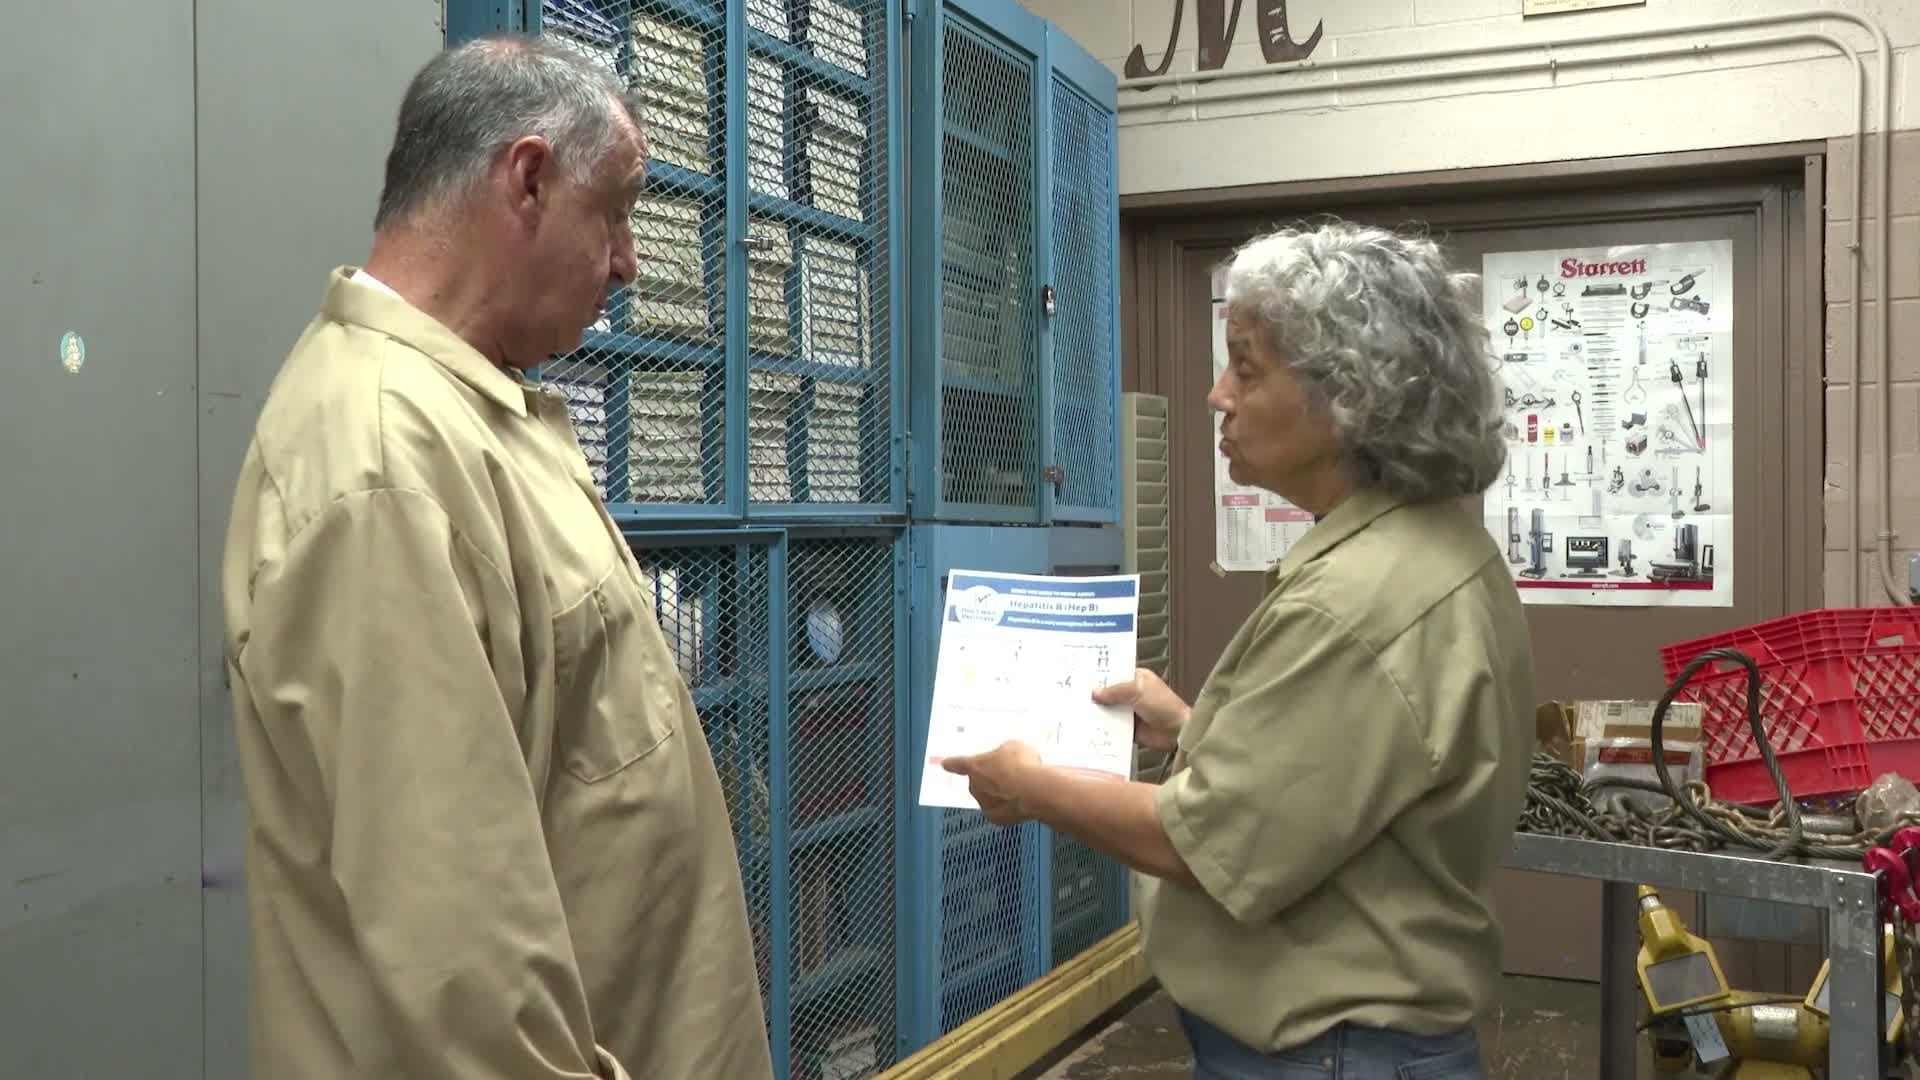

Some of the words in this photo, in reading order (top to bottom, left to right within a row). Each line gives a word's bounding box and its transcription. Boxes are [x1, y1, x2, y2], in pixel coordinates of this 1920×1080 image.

[1560, 258, 1646, 279] Starrett
[1010, 600, 1053, 612] Hepatitis
[1064, 602, 1087, 613] (Hep
